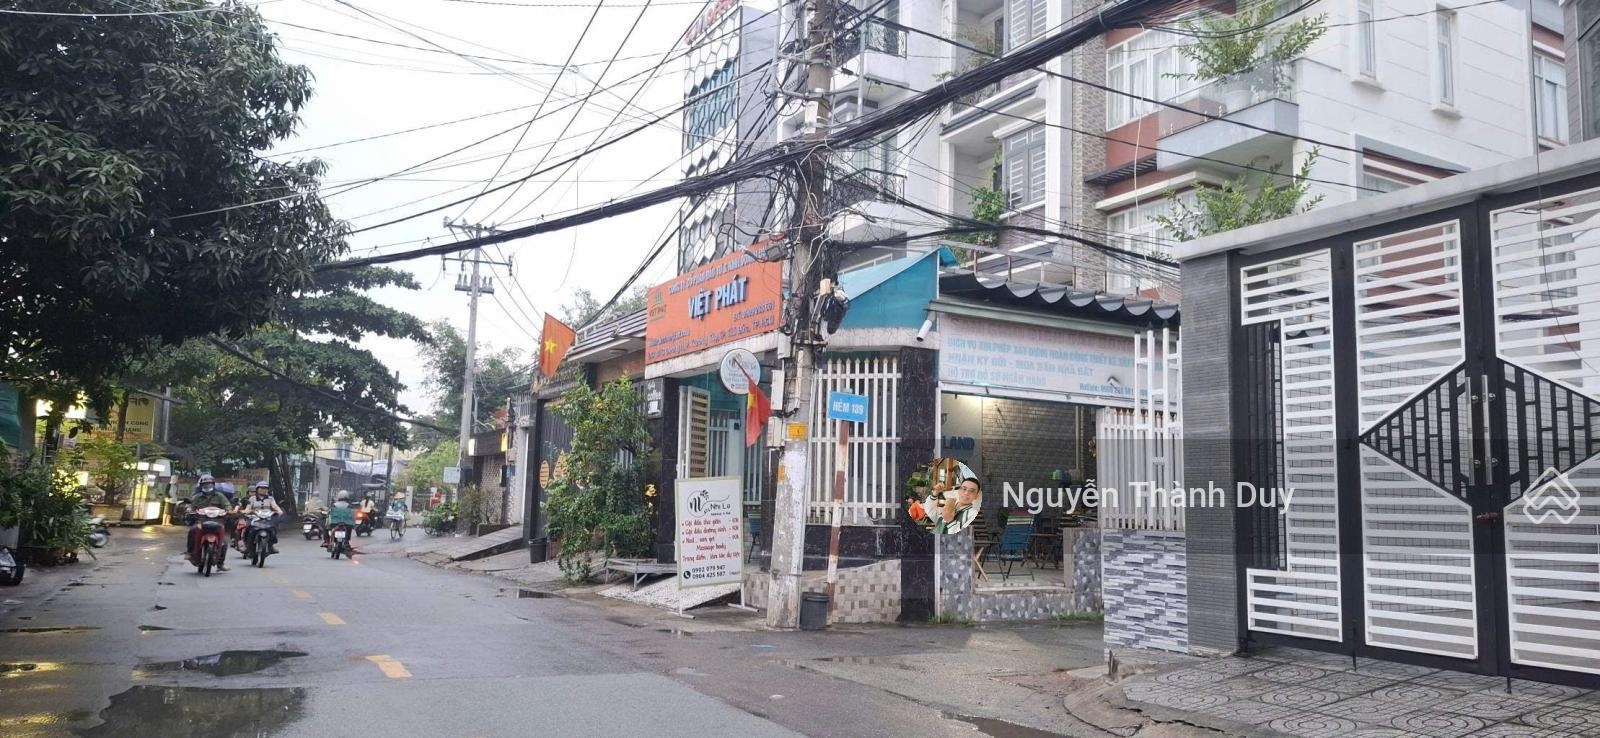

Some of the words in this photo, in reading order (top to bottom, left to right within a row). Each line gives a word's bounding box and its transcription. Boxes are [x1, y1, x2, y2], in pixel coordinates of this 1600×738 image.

[688, 287, 712, 320] VIỆT
[715, 274, 748, 311] PHÁT
[851, 403, 864, 415] 139
[942, 436, 975, 450] LAND
